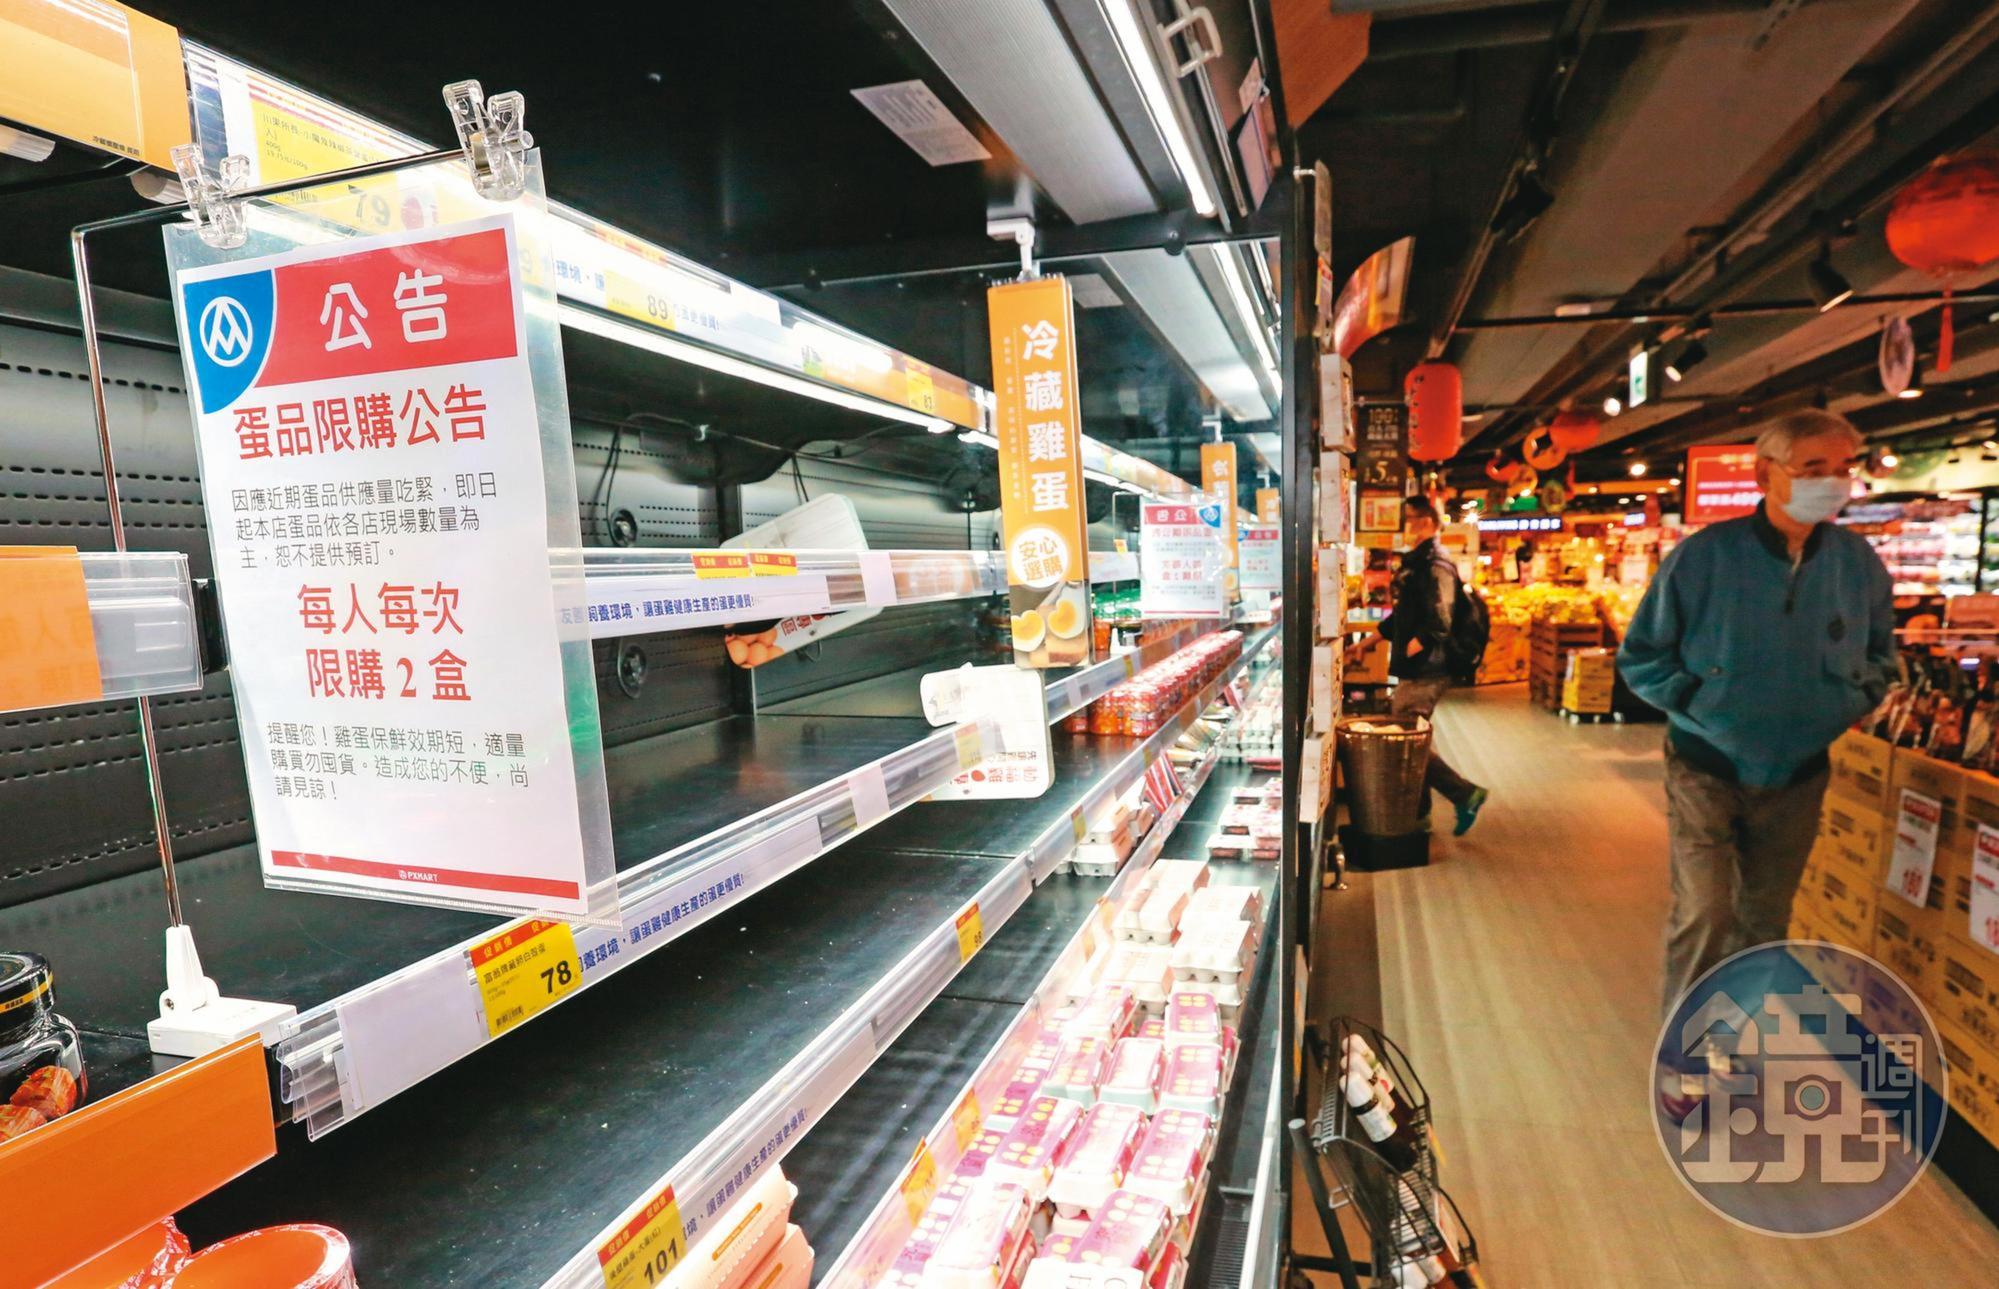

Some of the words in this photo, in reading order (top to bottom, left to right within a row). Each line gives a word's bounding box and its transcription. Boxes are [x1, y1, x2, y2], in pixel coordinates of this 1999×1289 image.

[319, 268, 448, 352] 公告
[647, 294, 668, 320] 89
[233, 384, 487, 460] 蛋品限購公告
[1021, 319, 1070, 512] 冷藏雞蛋
[231, 472, 497, 513] 因應近期蛋品供應量吃緊，即日
[236, 505, 480, 542] 起本店蛋品依各店現場數量為
[240, 540, 395, 569] 主，恕不提供預訂。
[1018, 535, 1058, 560] 安心
[297, 581, 464, 635] 每人每次
[267, 722, 527, 758] 提醒您！雞蛋保鮮效期短，適量
[270, 750, 529, 787] 購買勿囤貨。造成您的不便，尚
[275, 777, 338, 800] 請見諒！
[407, 871, 439, 883] PXMART
[540, 960, 573, 995] 78
[643, 1237, 678, 1283] 101
